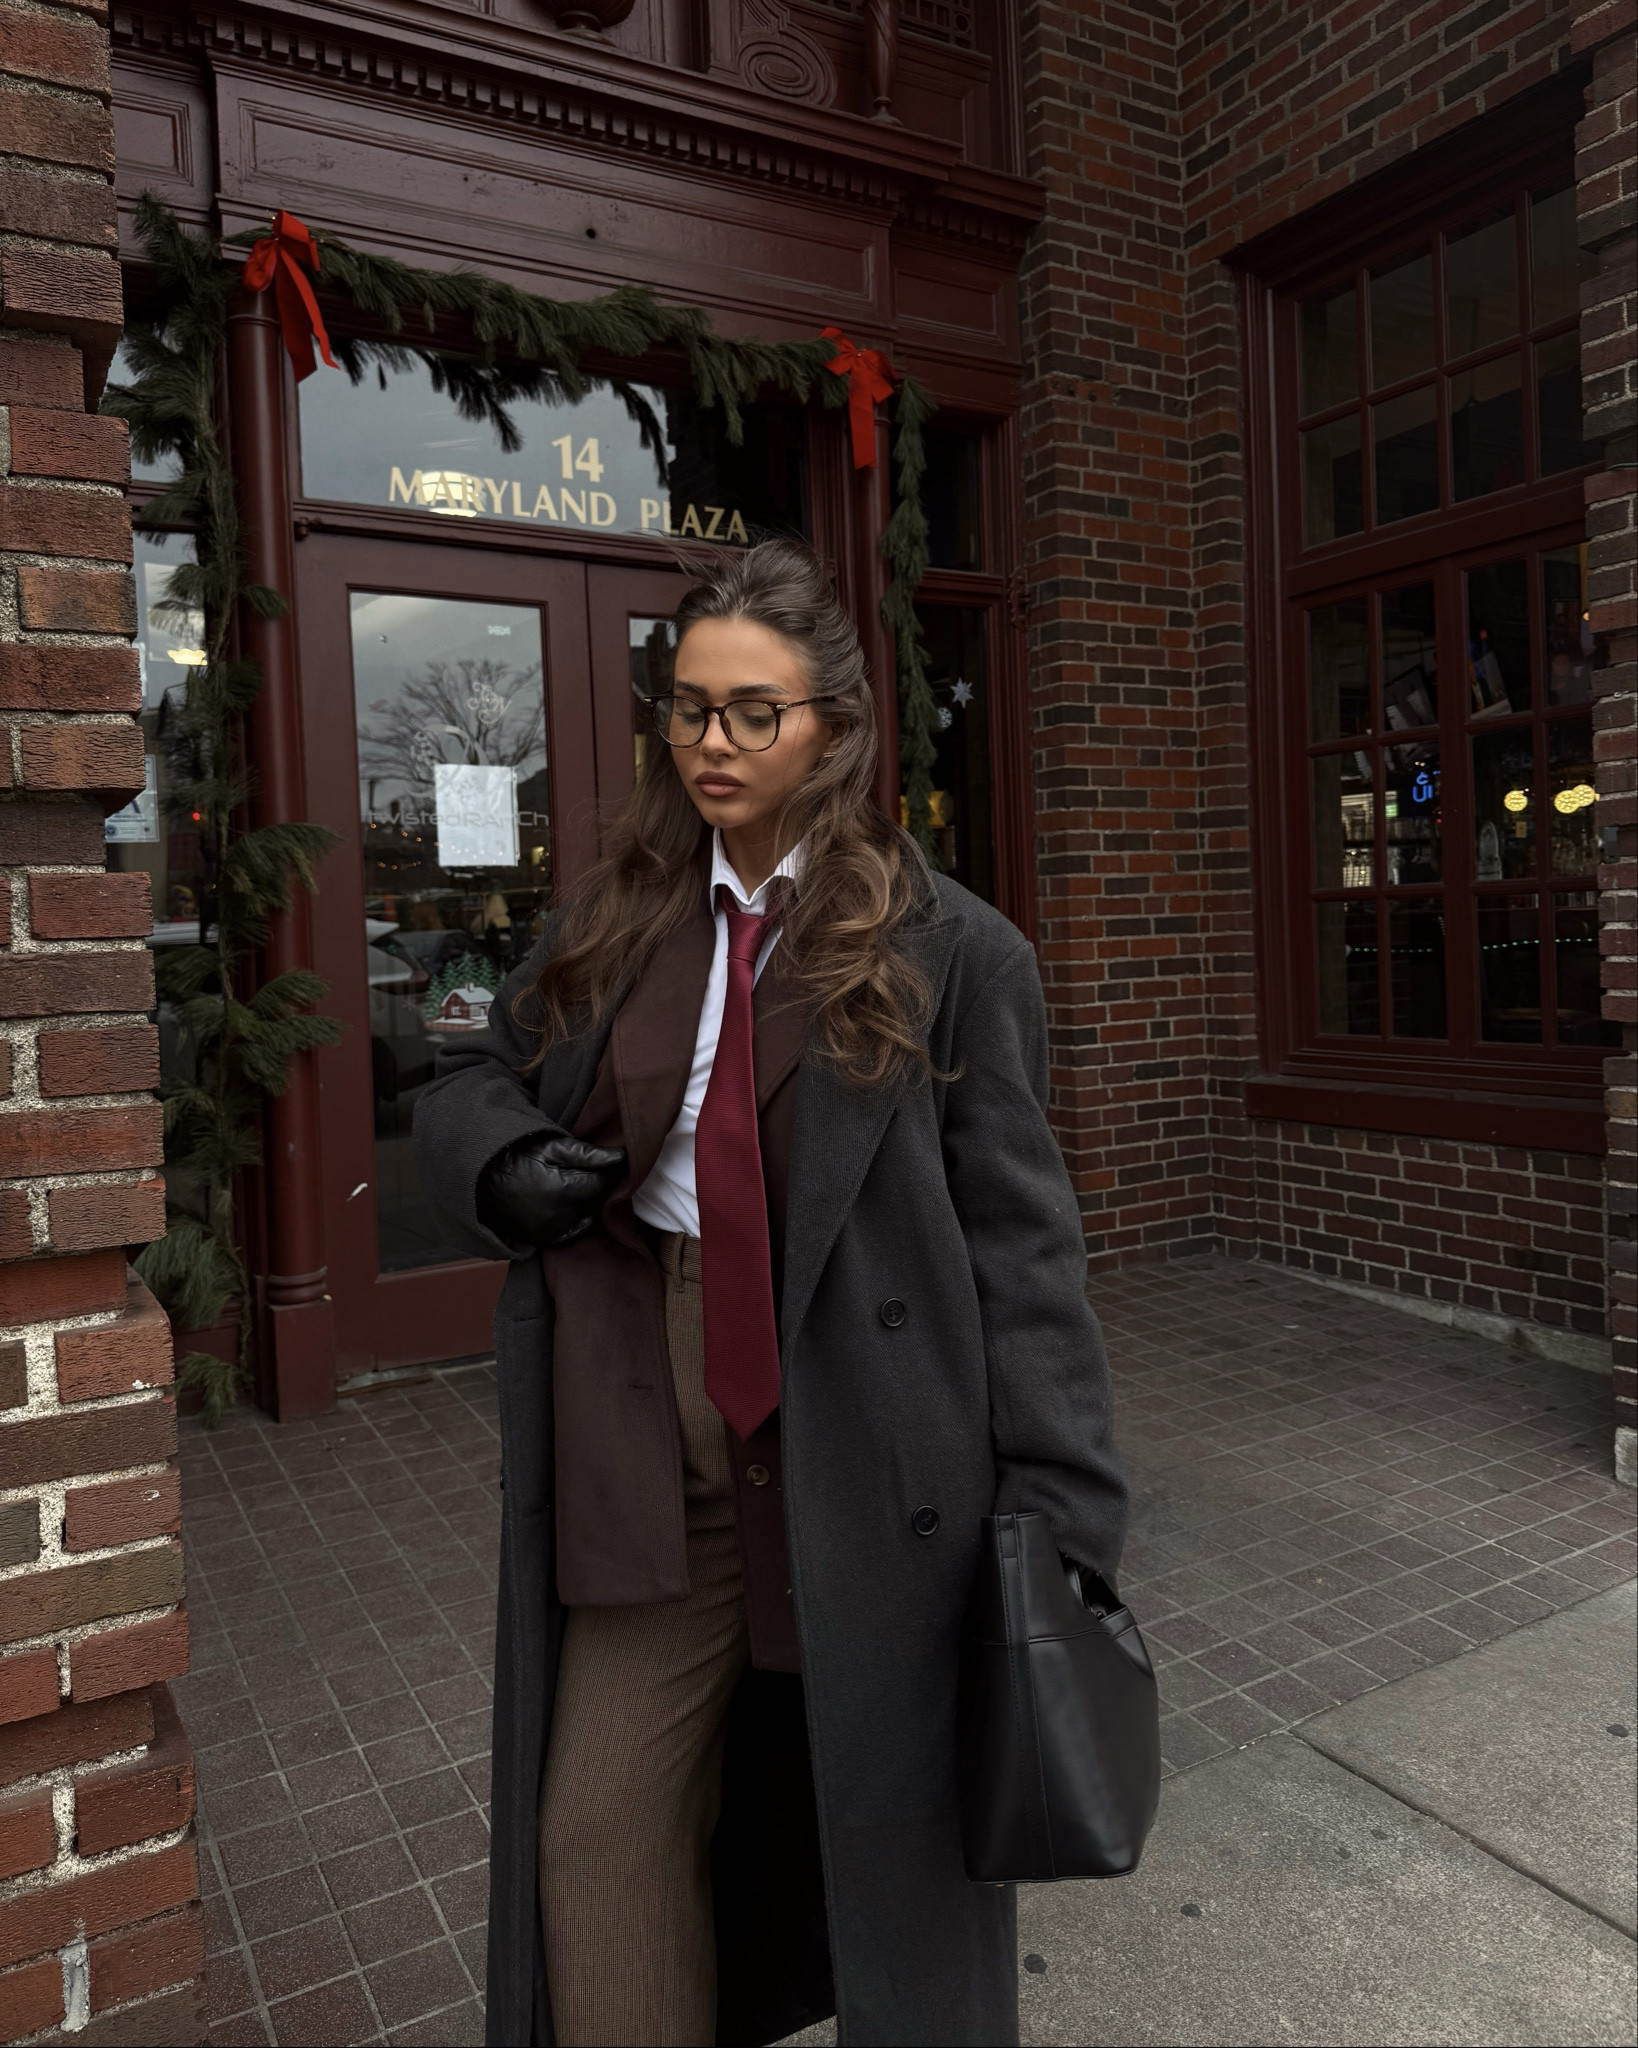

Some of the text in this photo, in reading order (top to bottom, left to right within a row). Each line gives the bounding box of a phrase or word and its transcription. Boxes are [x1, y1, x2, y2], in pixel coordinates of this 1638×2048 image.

[551, 435, 604, 483] 14
[388, 466, 749, 544] MARYLAND PLAZA
